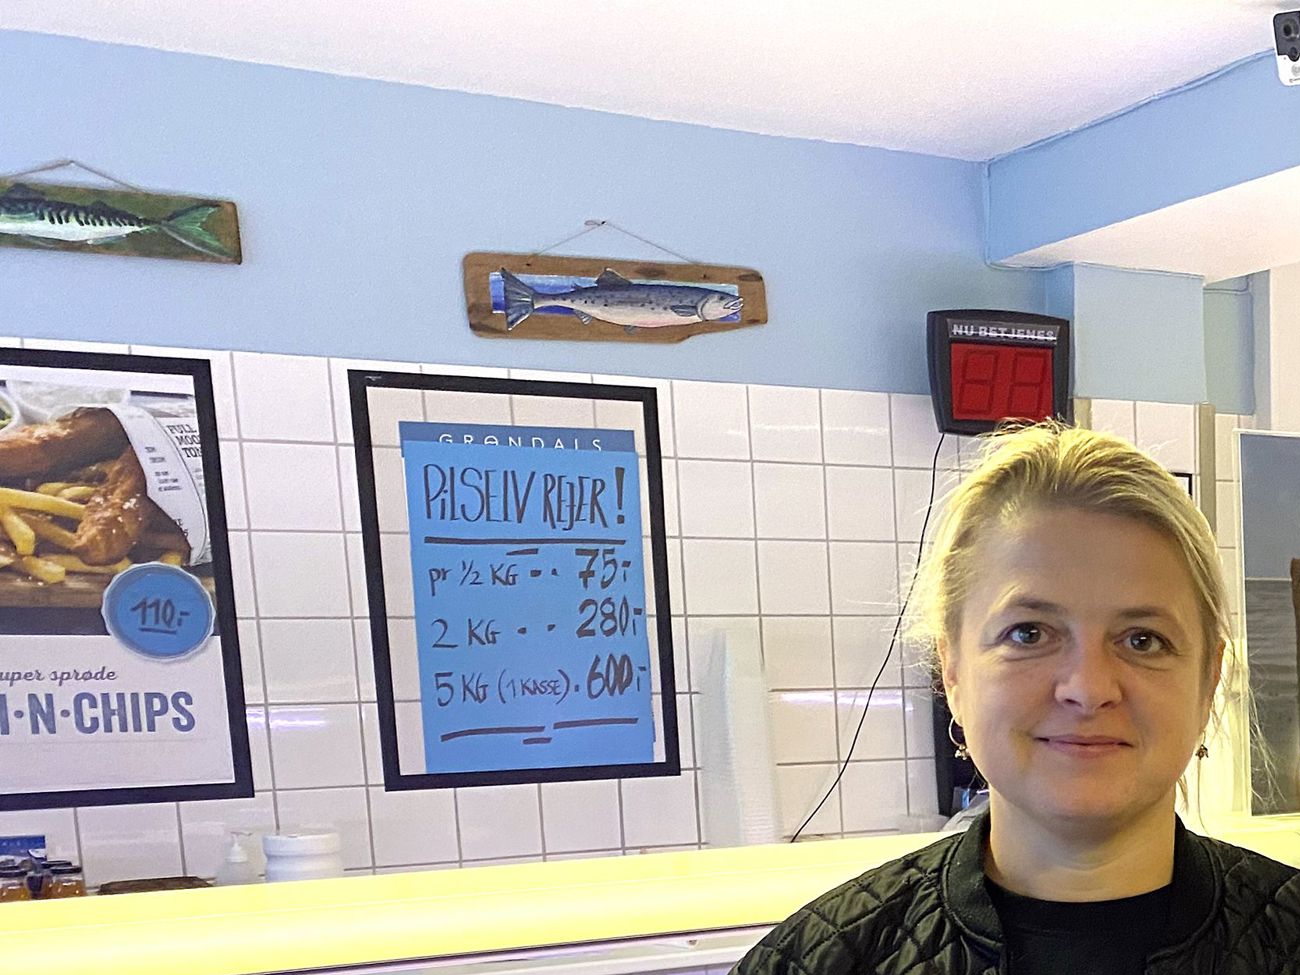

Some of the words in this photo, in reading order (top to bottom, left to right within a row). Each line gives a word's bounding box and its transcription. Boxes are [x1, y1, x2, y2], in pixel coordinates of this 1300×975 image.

[953, 324, 975, 336] NU
[490, 563, 518, 586] KG
[431, 618, 458, 648] 2
[467, 618, 502, 646] KG
[434, 672, 454, 707] 5
[461, 672, 489, 704] KG
